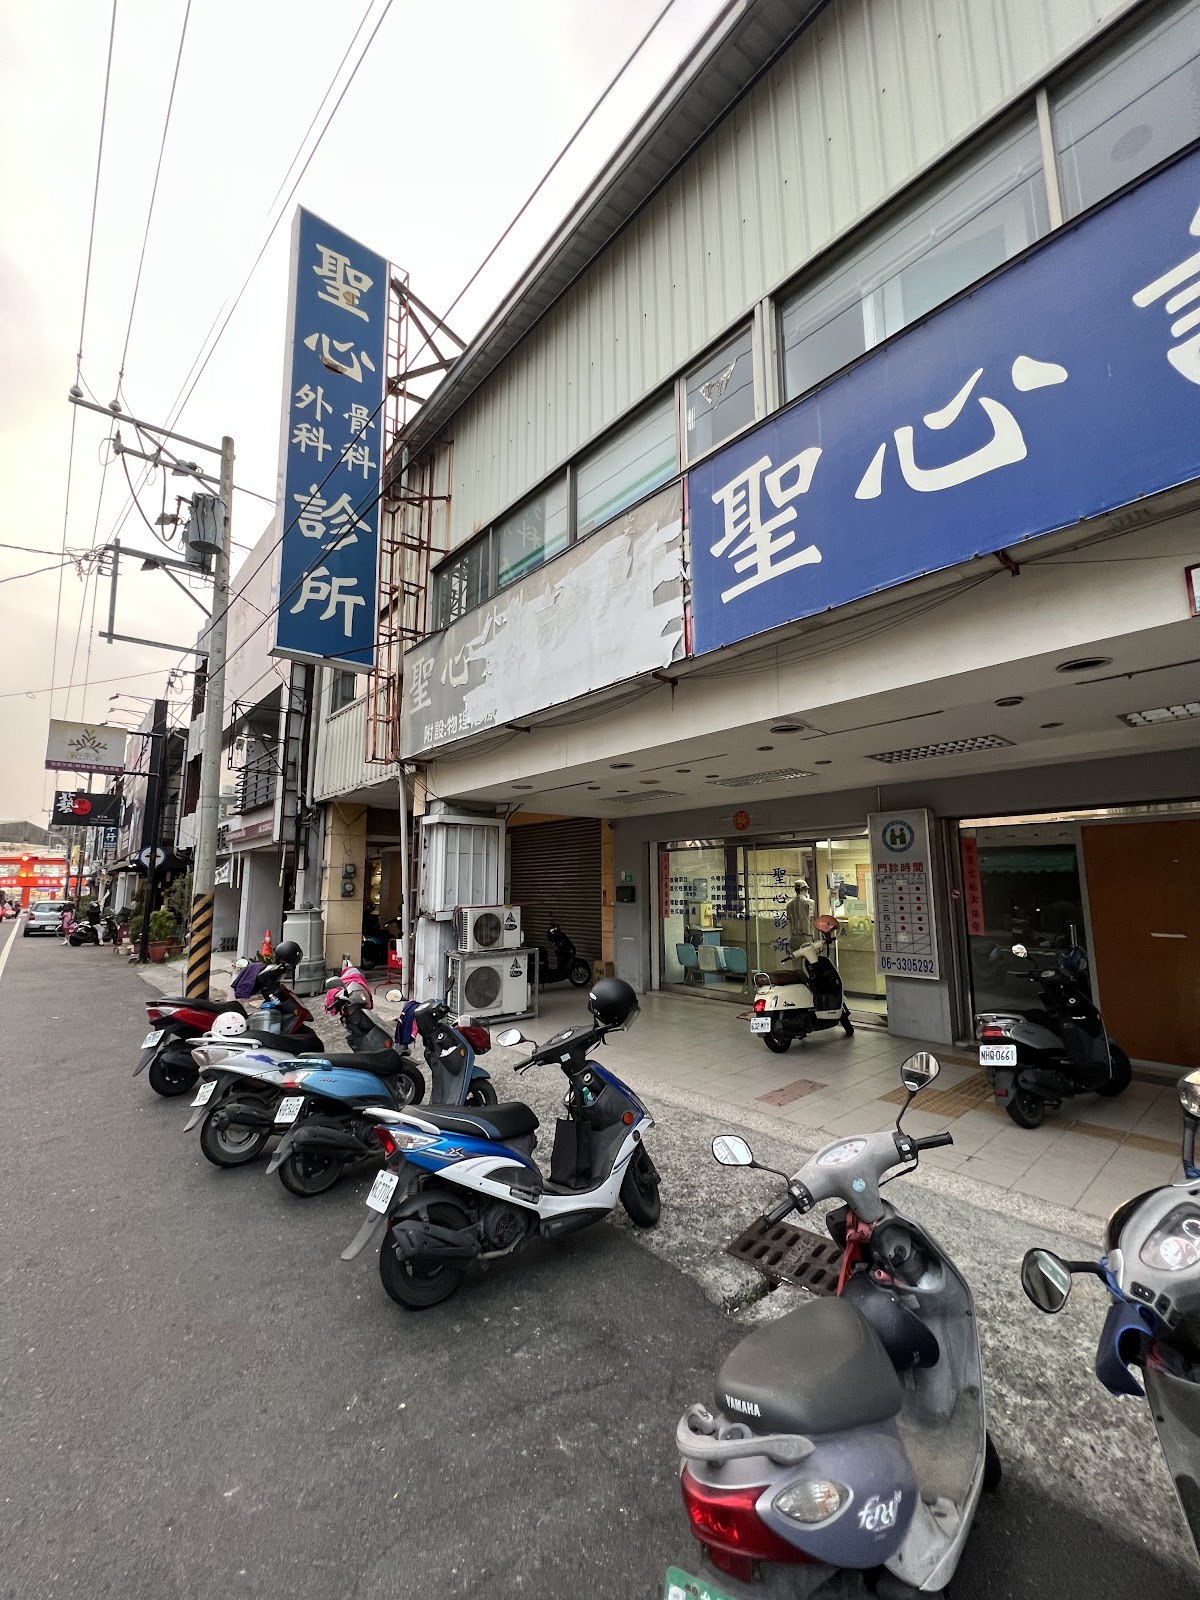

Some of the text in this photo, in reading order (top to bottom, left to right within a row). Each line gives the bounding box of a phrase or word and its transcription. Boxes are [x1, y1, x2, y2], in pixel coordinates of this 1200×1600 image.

[303, 243, 375, 383] 聖心
[292, 384, 333, 462] 外科
[340, 403, 377, 480] 骨科
[289, 483, 372, 637] 診所
[877, 862, 924, 873] 門診時間
[881, 957, 934, 973] 06-3305292
[981, 1050, 1014, 1061] NHQ-0661
[725, 1394, 761, 1418] YAMAHA
